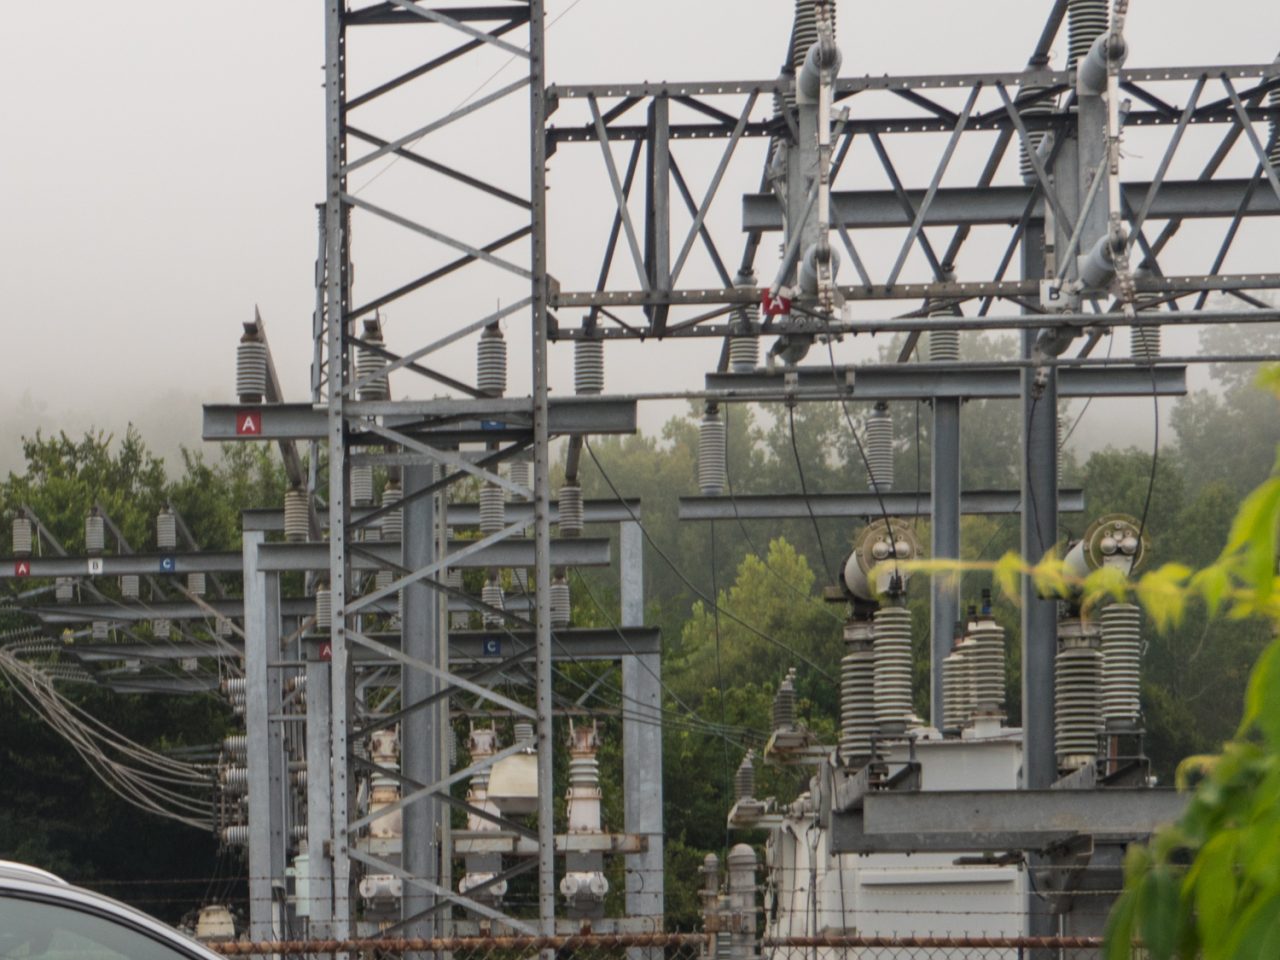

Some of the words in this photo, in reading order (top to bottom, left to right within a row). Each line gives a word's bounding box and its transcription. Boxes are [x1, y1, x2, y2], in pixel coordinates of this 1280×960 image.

[242, 415, 255, 431] A
[92, 561, 99, 570] B
[162, 558, 171, 568] C
[18, 563, 27, 574] A
[486, 642, 496, 651] C
